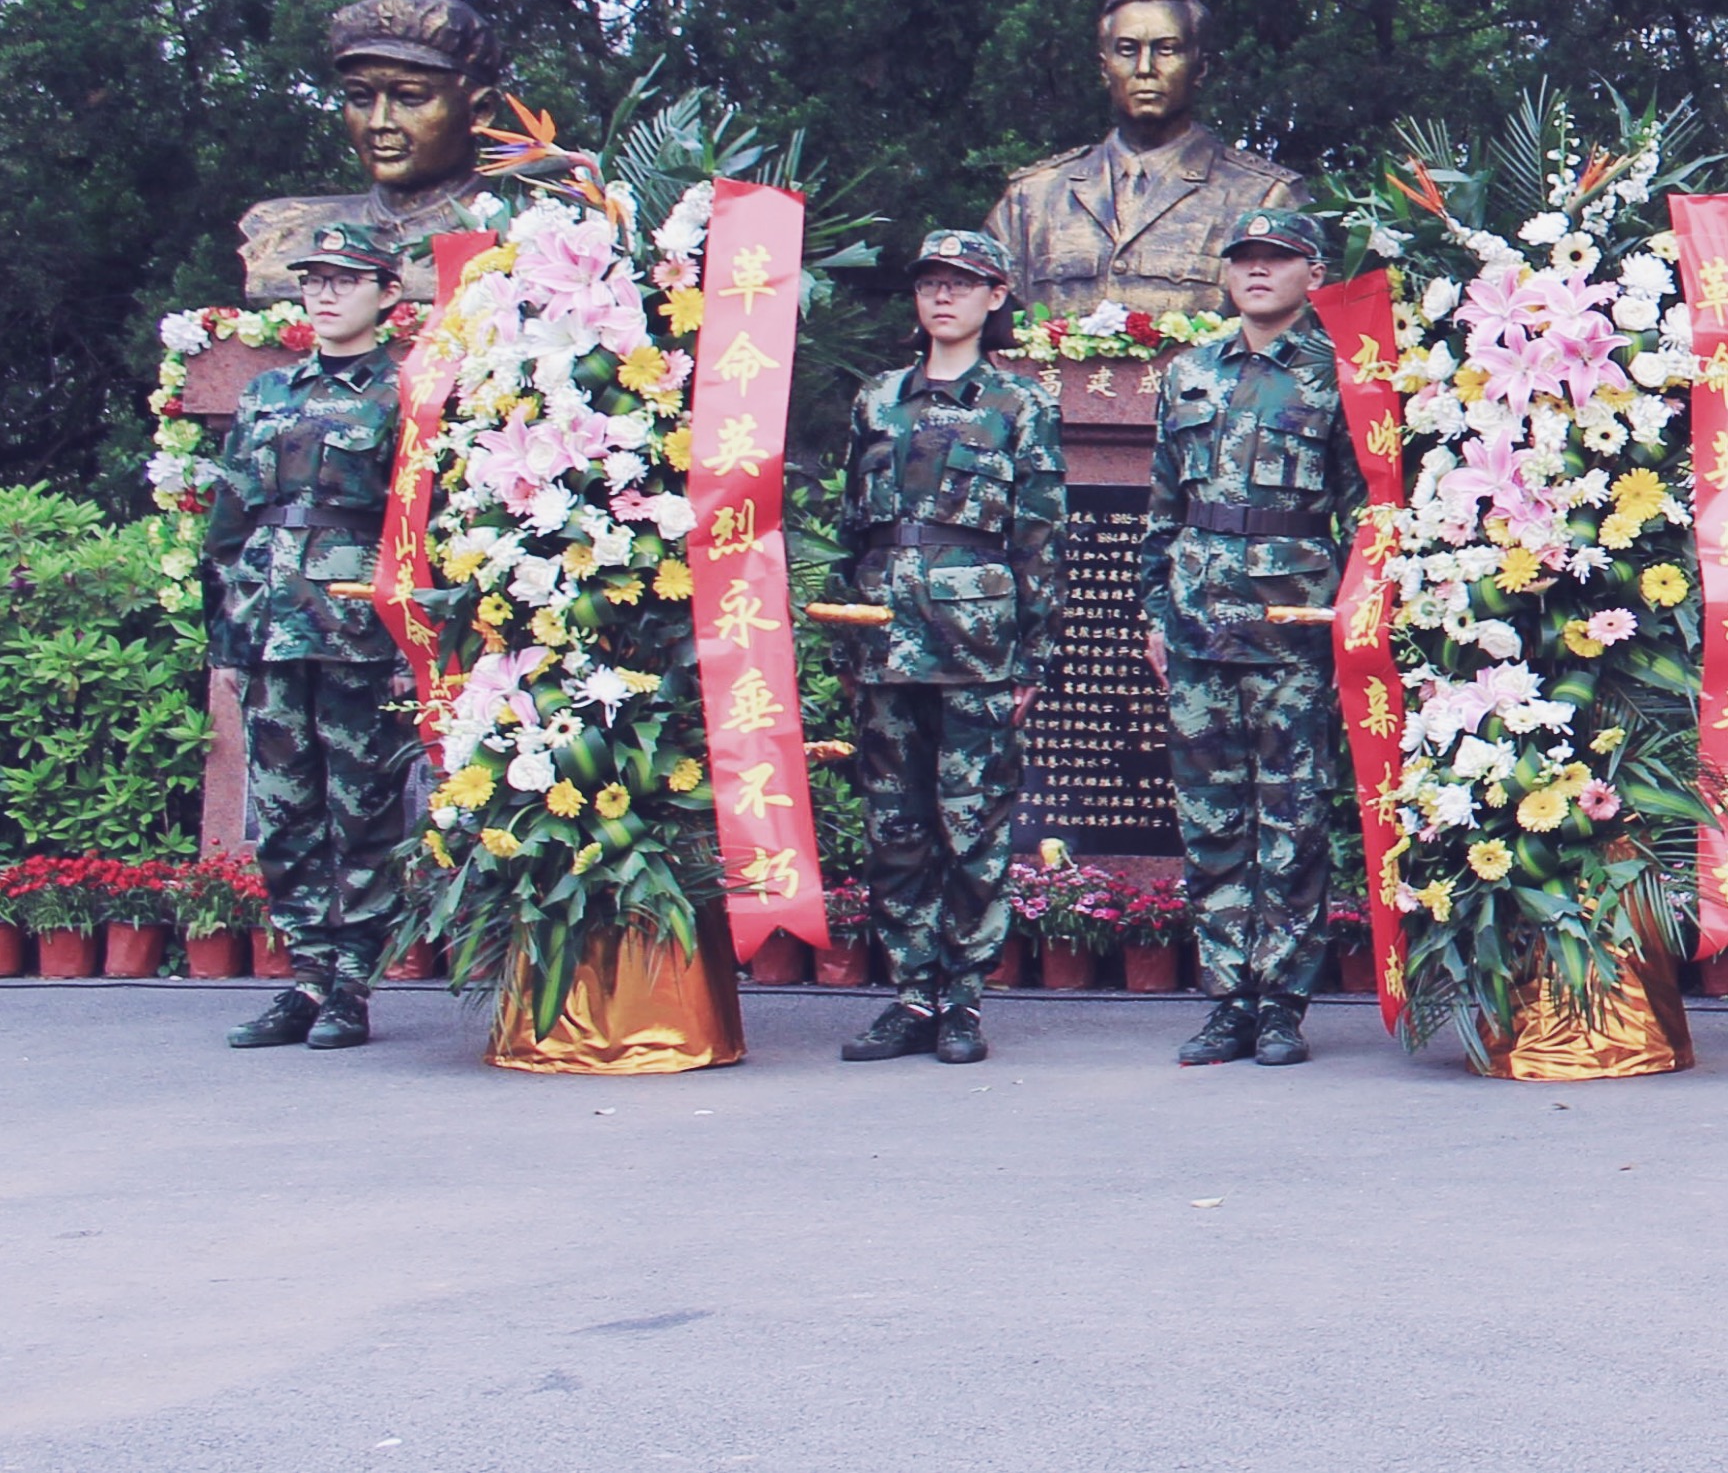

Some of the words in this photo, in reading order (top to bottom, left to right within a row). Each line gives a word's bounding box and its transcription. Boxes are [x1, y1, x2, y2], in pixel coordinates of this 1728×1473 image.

[1038, 364, 1163, 398] 高建成
[701, 244, 798, 907] 革命英烈永垂不朽
